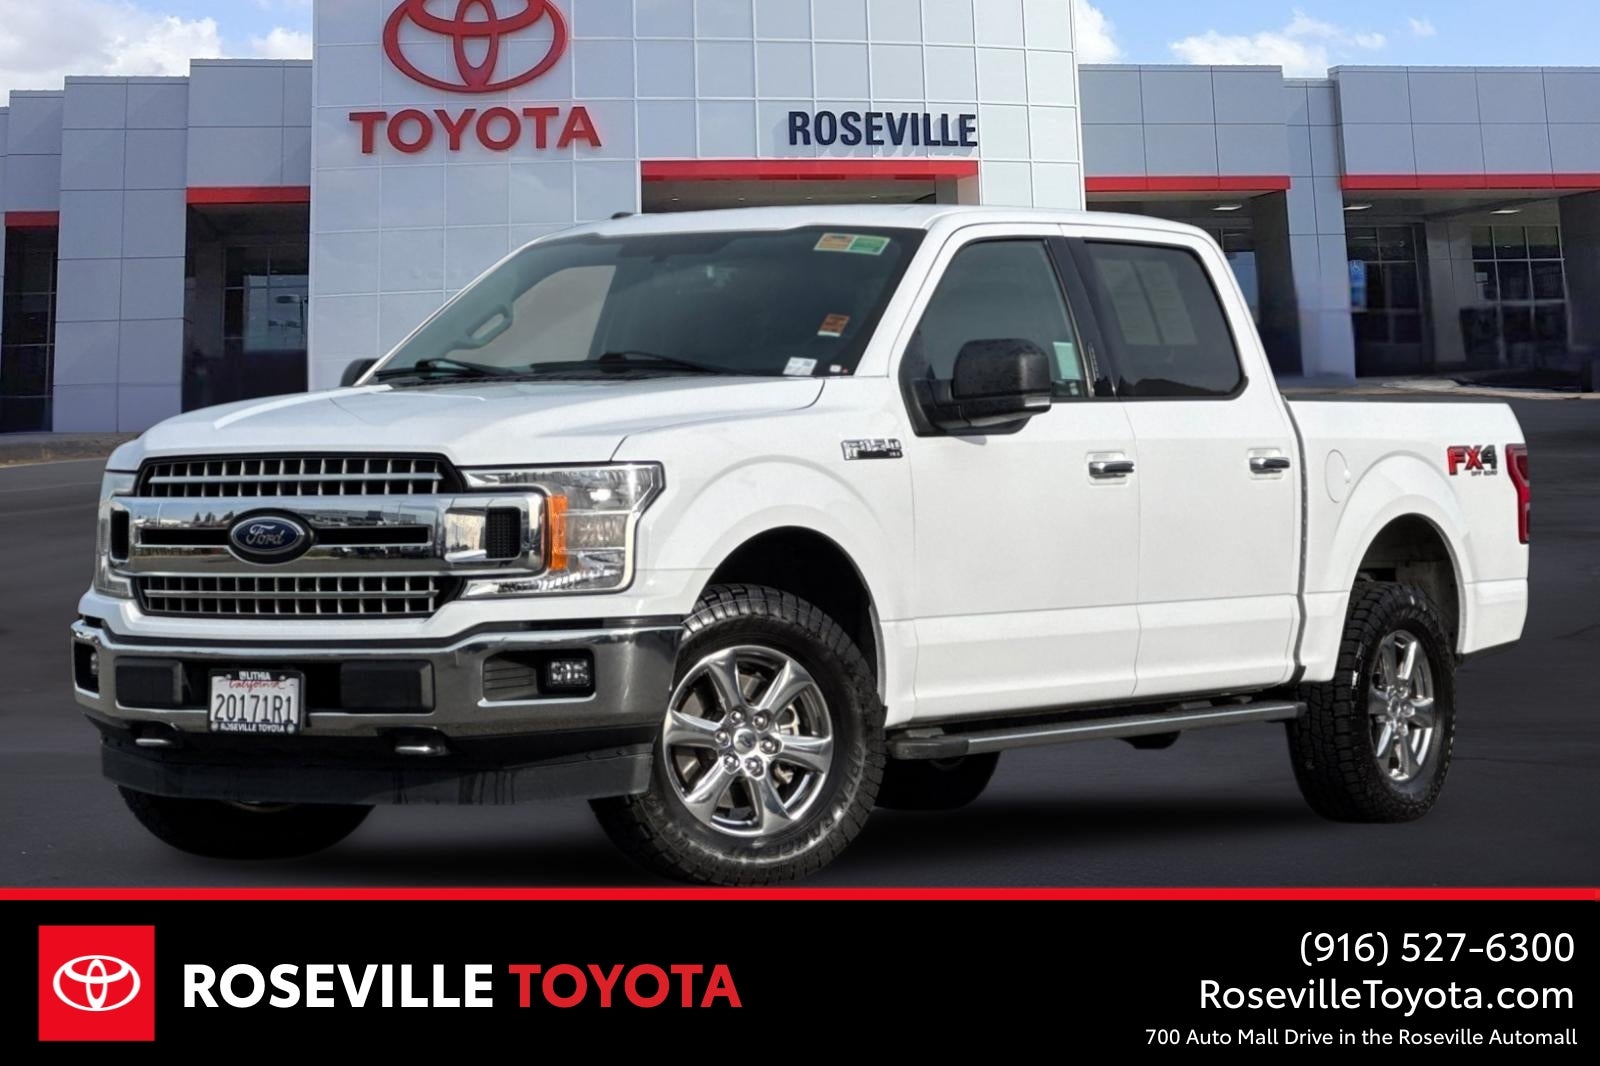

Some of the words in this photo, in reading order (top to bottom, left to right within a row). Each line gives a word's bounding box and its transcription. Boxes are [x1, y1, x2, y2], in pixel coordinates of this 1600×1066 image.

[349, 106, 602, 154] TOYOTA
[788, 110, 978, 148] ROSEVILLE
[1447, 444, 1498, 475] FX4
[246, 523, 286, 545] Ford
[214, 693, 294, 723] 20171R1
[258, 723, 285, 733] TOYOTA
